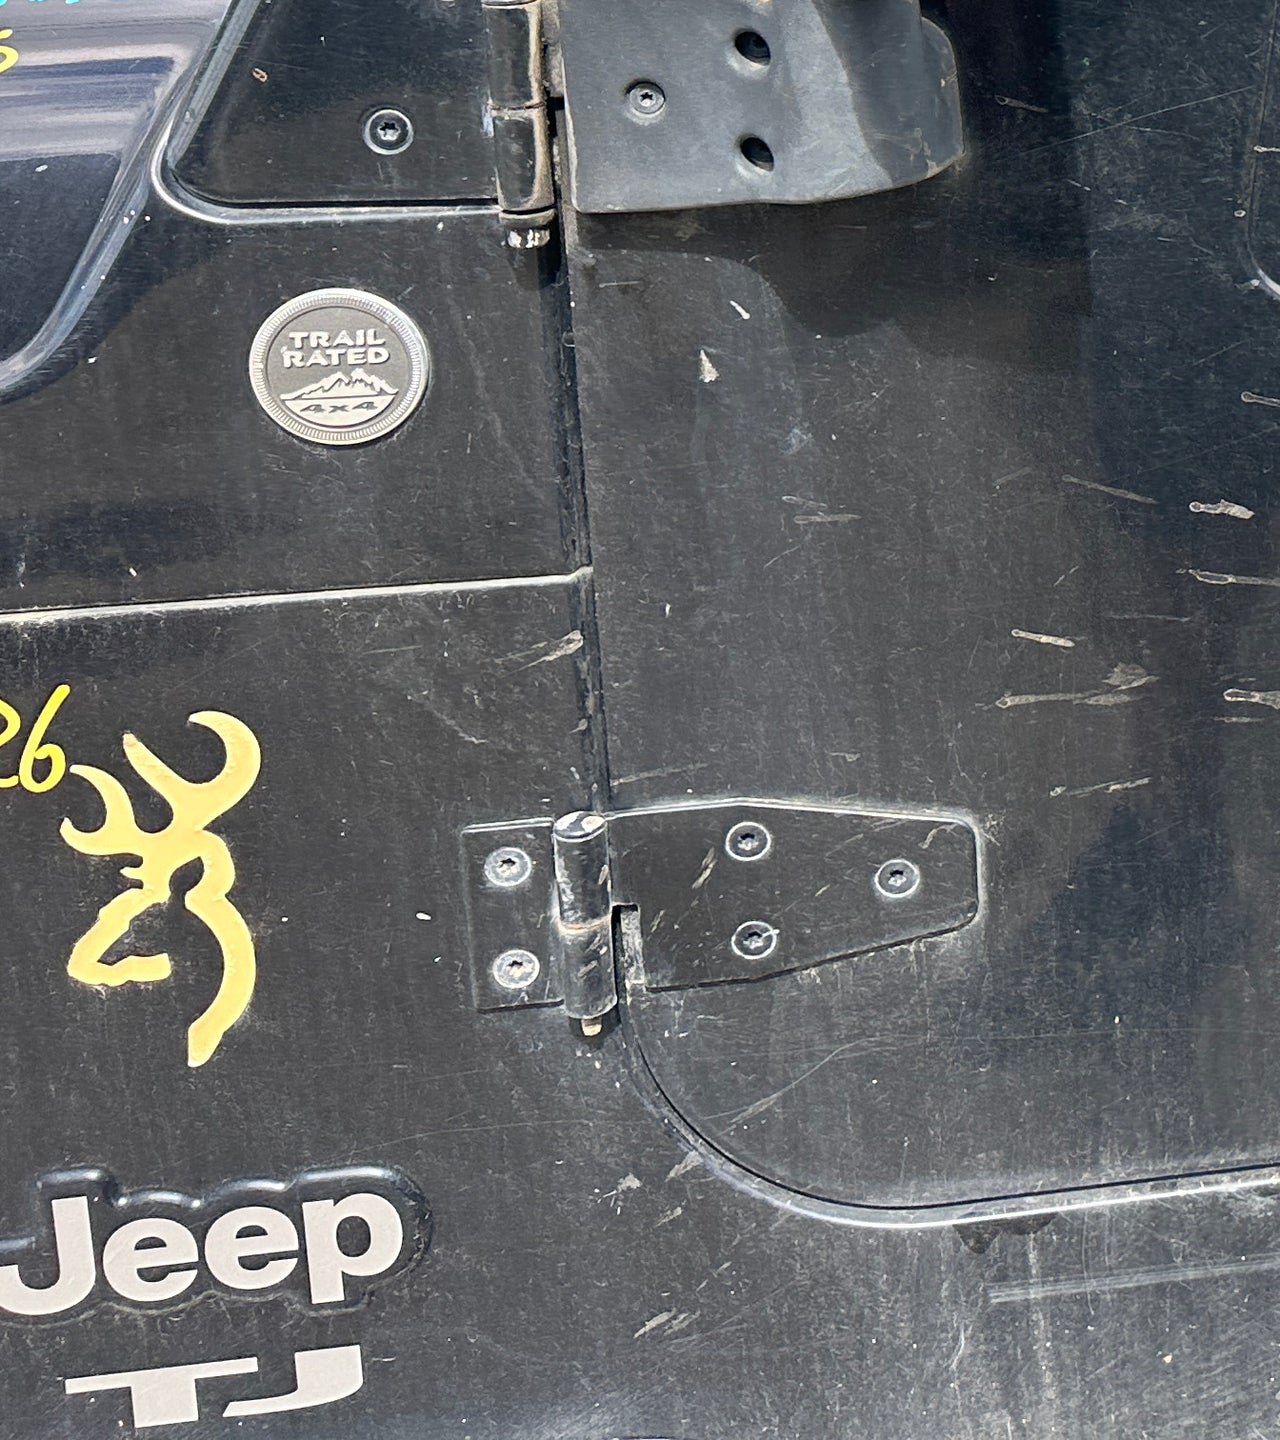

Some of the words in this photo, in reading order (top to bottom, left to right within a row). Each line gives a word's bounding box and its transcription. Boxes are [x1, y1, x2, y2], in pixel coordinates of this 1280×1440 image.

[281, 346, 391, 369] RATED
[288, 328, 387, 350] TRAIL
[0, 1192, 404, 1316] Jeep
[64, 1344, 365, 1429] TJ
